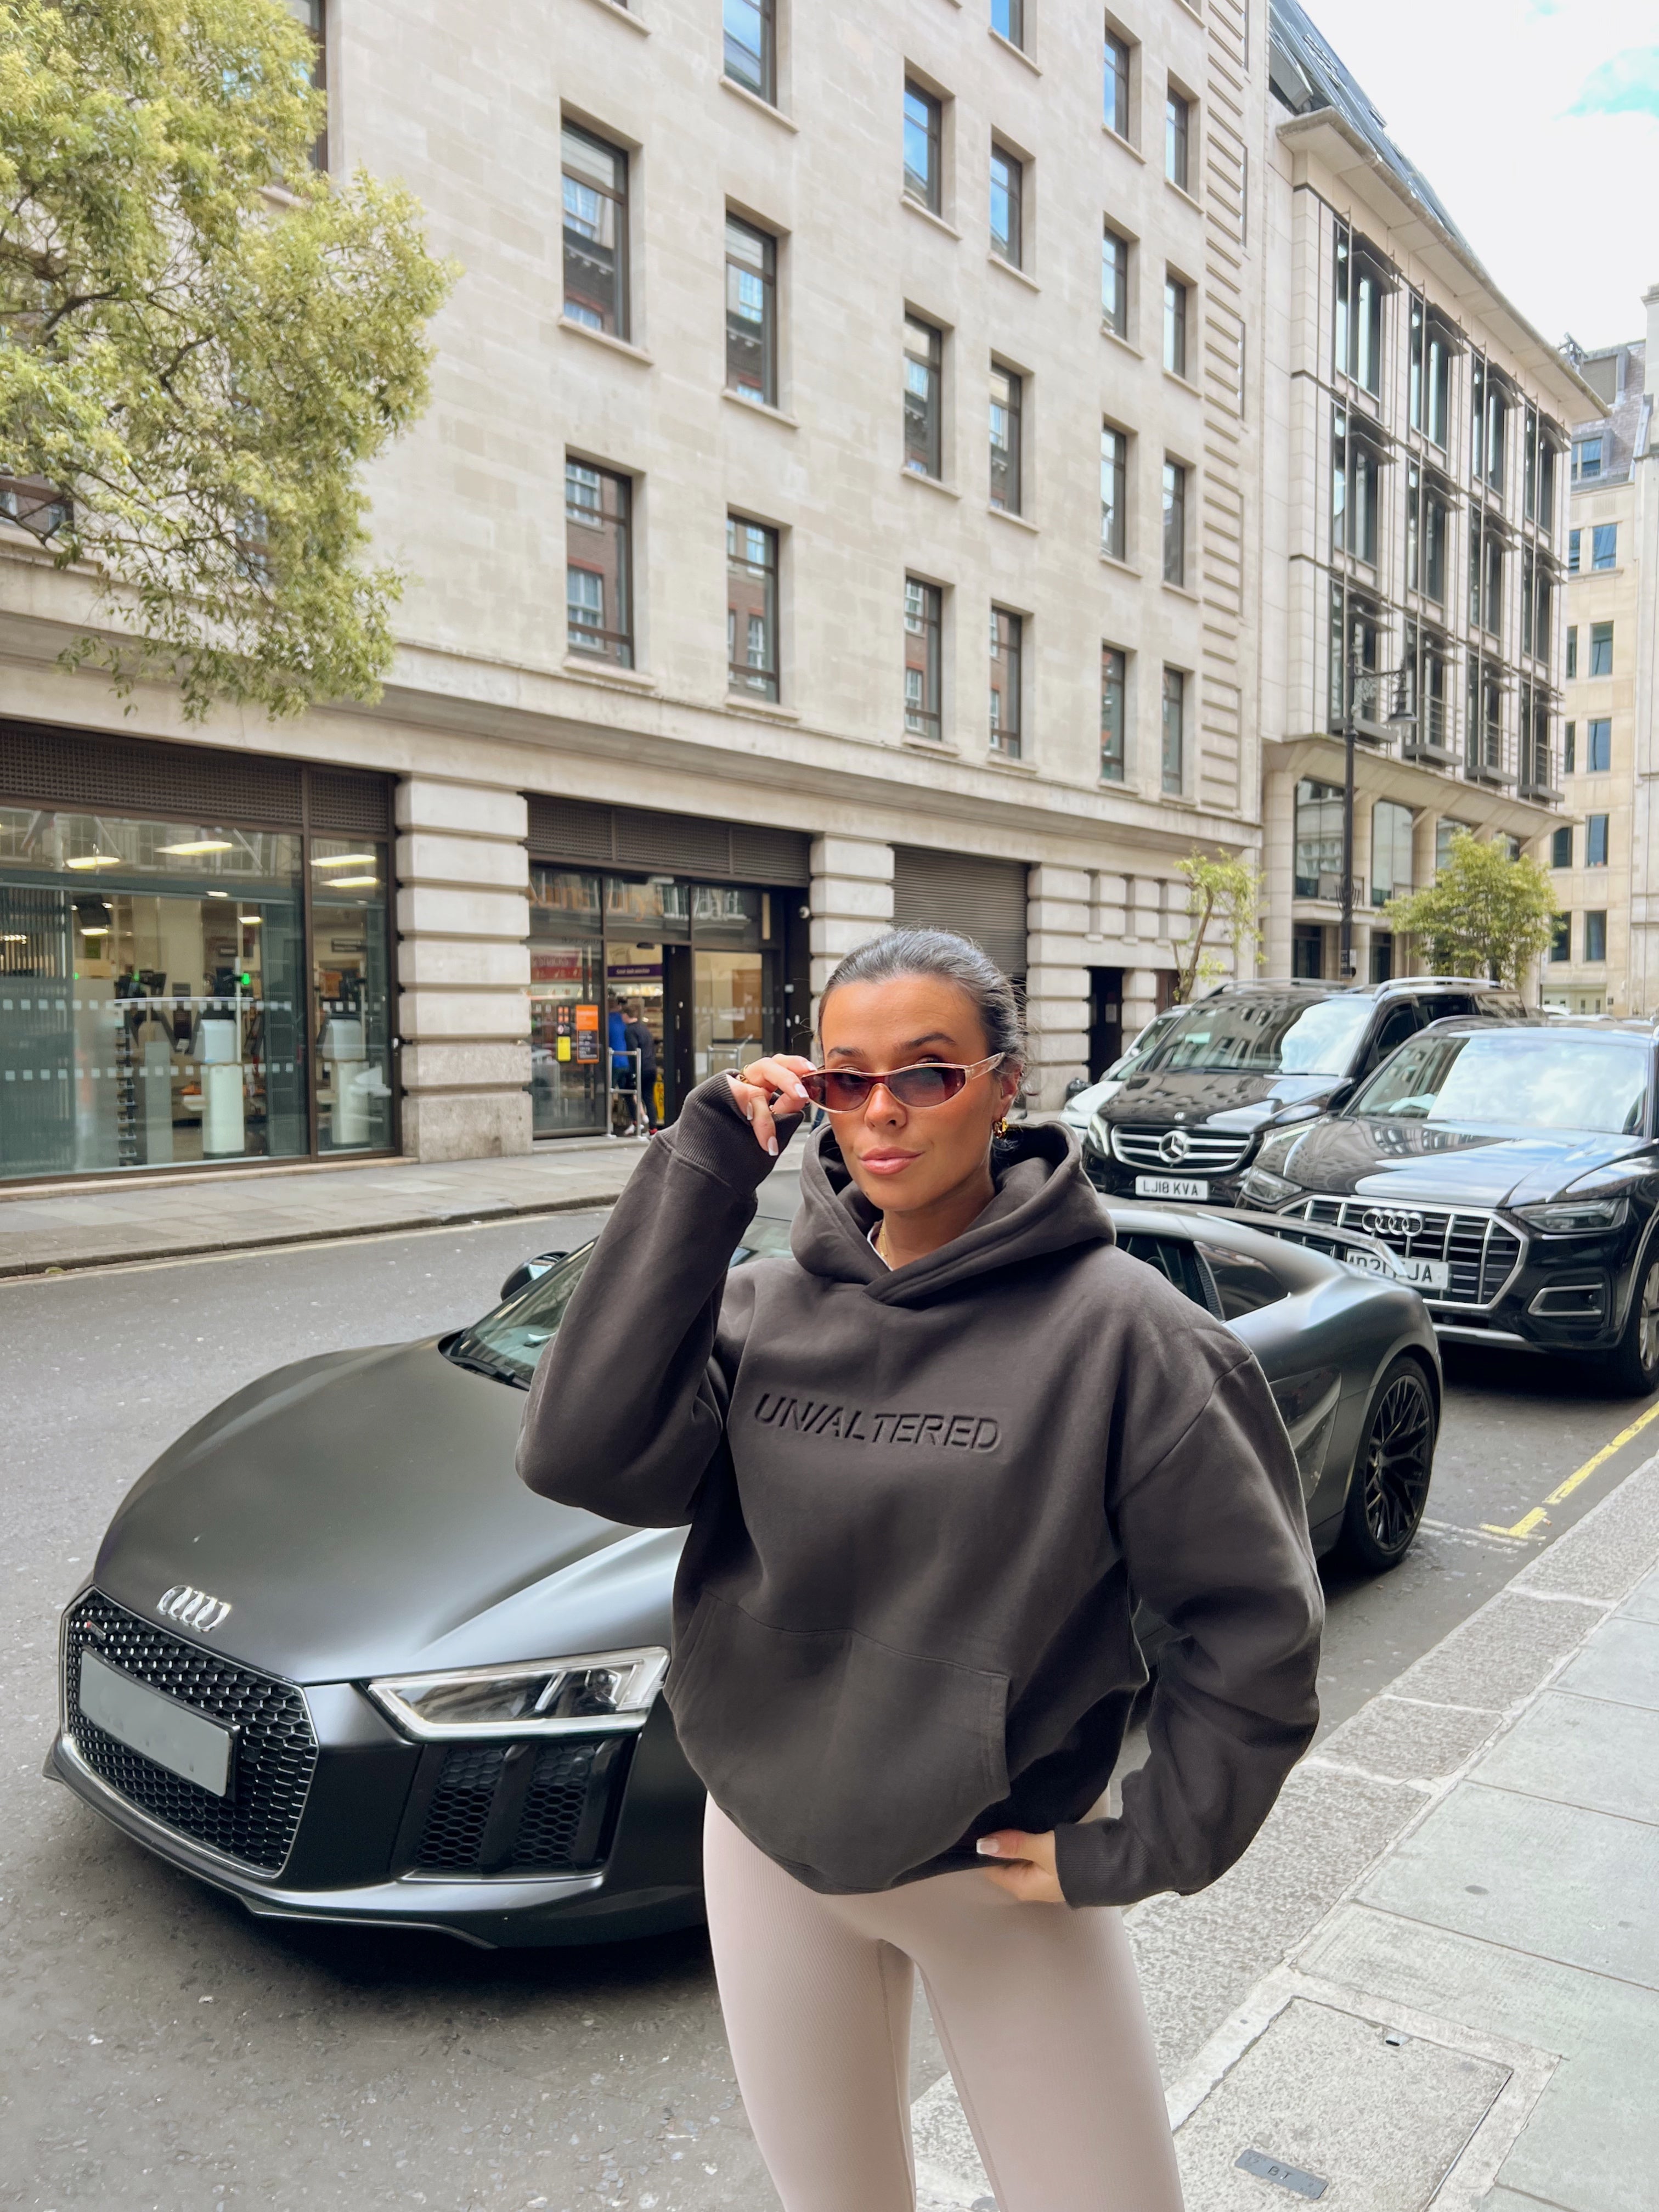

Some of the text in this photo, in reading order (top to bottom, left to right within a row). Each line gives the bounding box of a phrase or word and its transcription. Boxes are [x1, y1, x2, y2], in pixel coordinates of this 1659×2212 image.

[1143, 1179, 1199, 1196] LJ18 KVA
[1393, 1262, 1432, 1282] JA
[1267, 2165, 1295, 2180] BT
